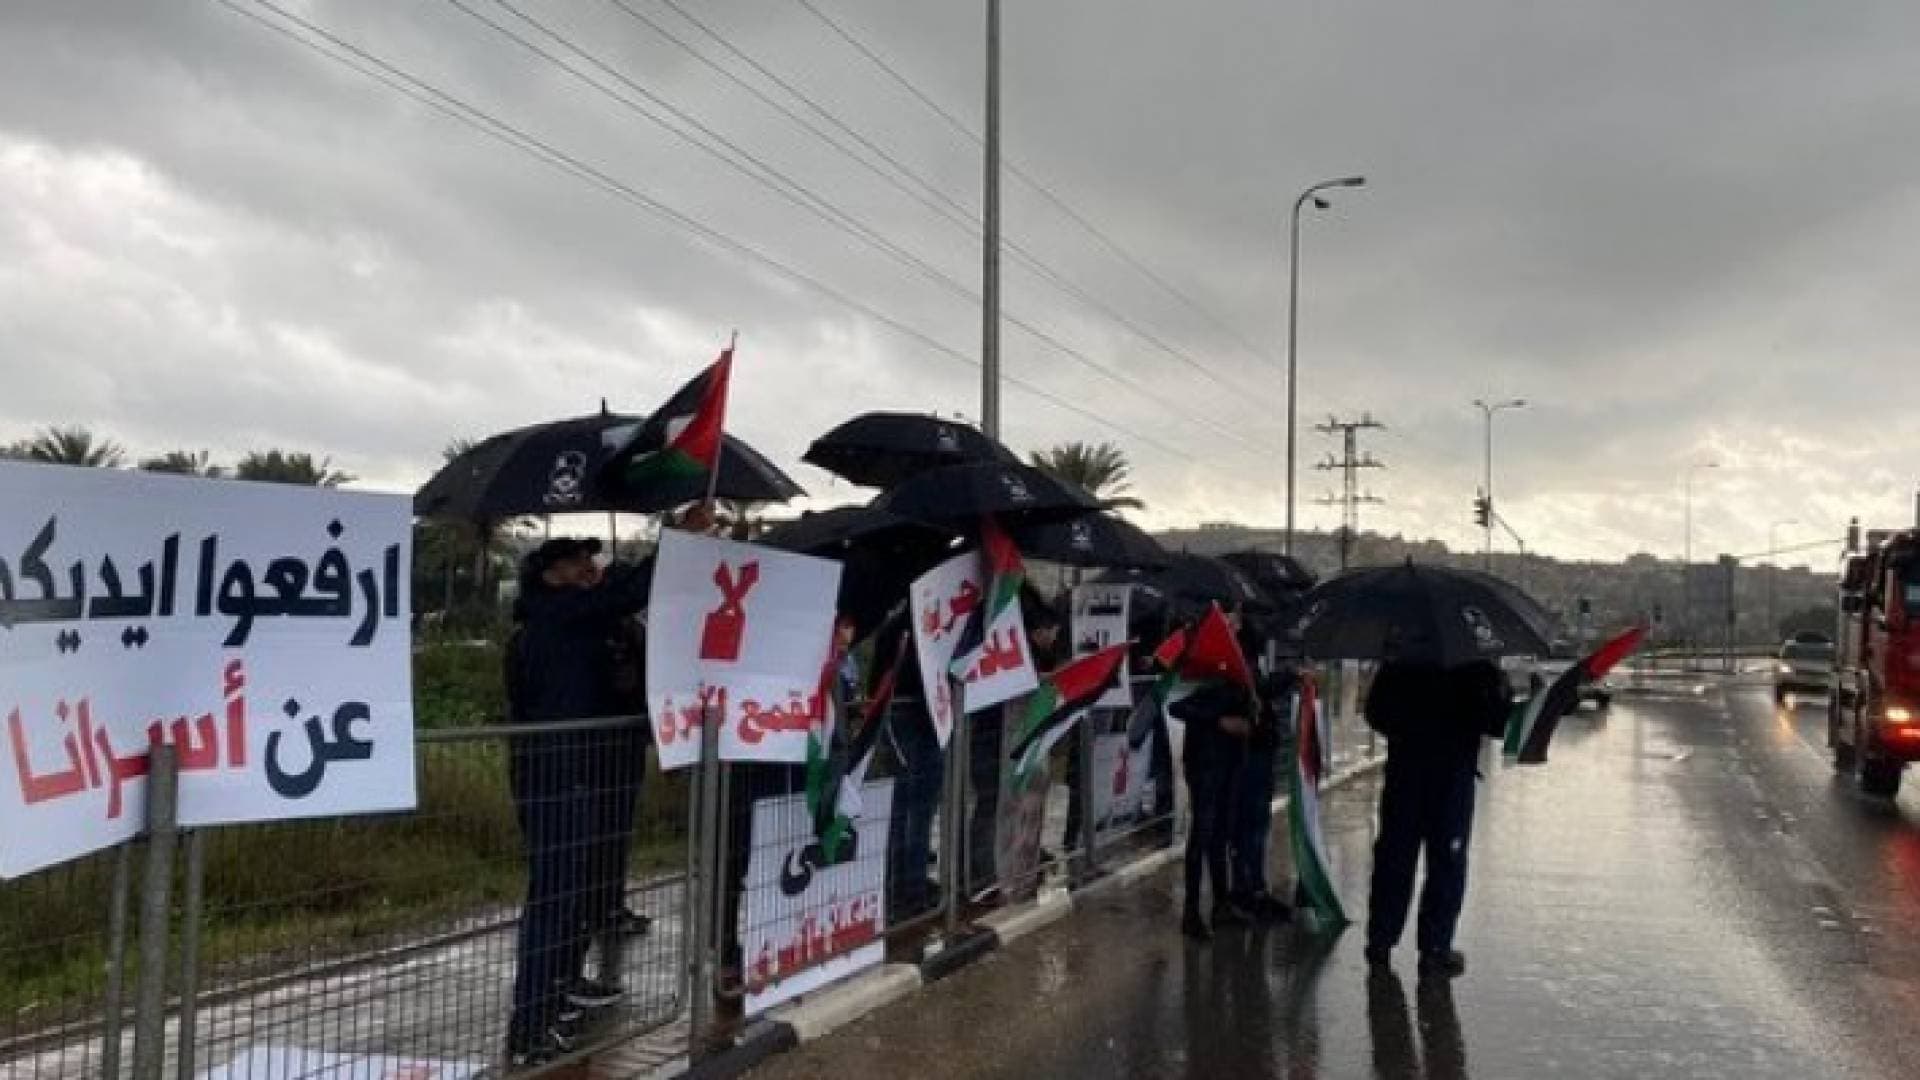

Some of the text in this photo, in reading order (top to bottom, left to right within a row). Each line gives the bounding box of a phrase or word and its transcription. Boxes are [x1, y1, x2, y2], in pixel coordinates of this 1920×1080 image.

[195, 518, 400, 648] ارفعوا
[700, 560, 760, 660] لا
[7, 658, 374, 820] عن أسرانا
